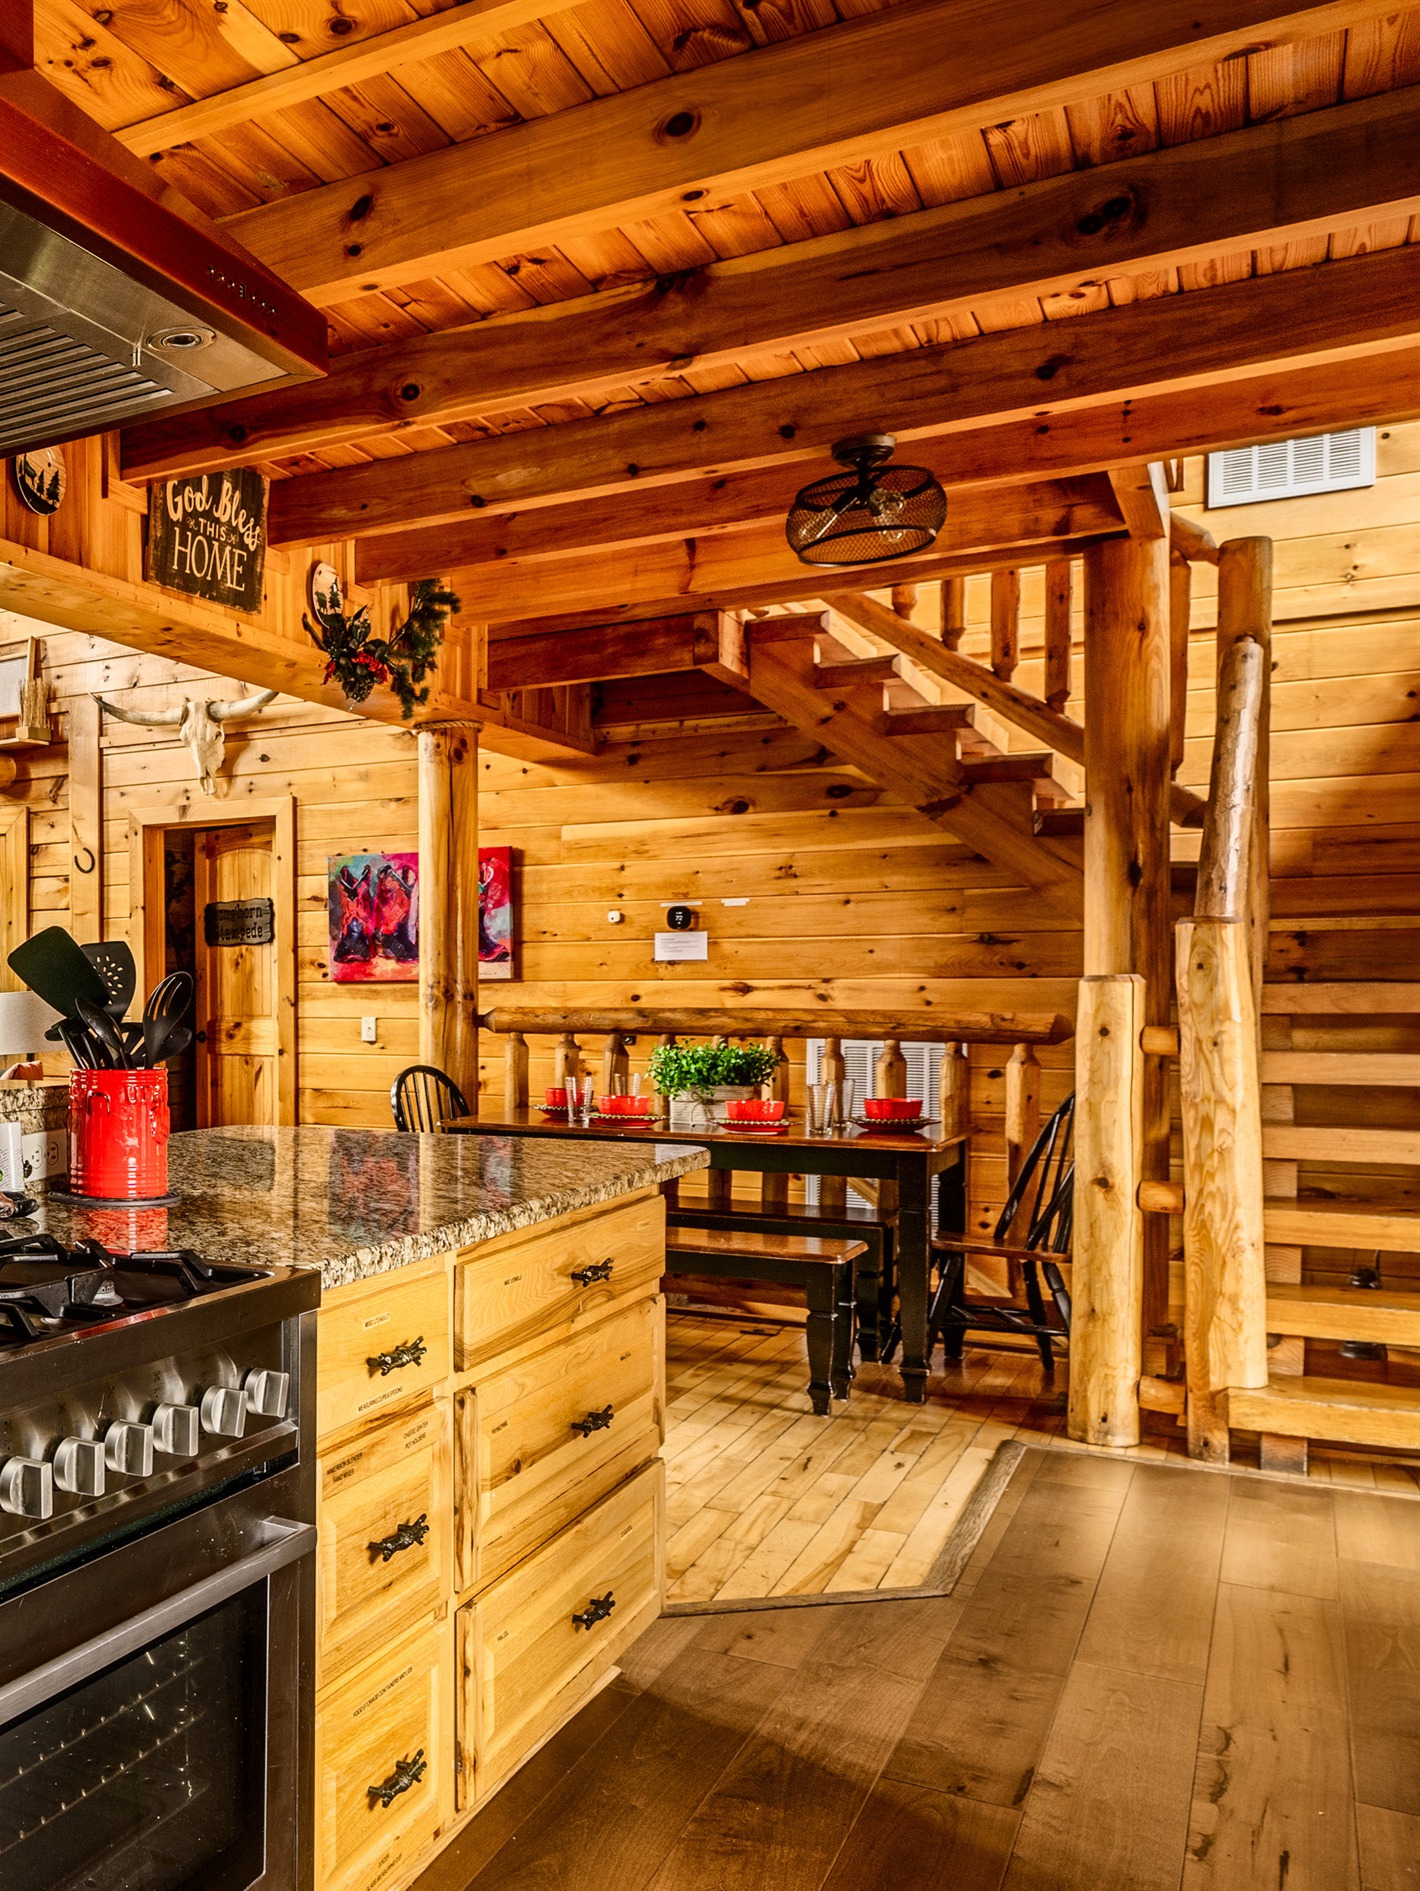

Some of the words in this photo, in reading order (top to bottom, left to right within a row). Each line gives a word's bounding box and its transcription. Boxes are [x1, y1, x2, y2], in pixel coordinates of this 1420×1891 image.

[166, 475, 212, 522] God
[213, 480, 261, 551] Bless
[198, 518, 226, 541] THIS
[172, 527, 247, 591] HOME
[212, 904, 263, 923] onghorn
[212, 922, 263, 942] tampede
